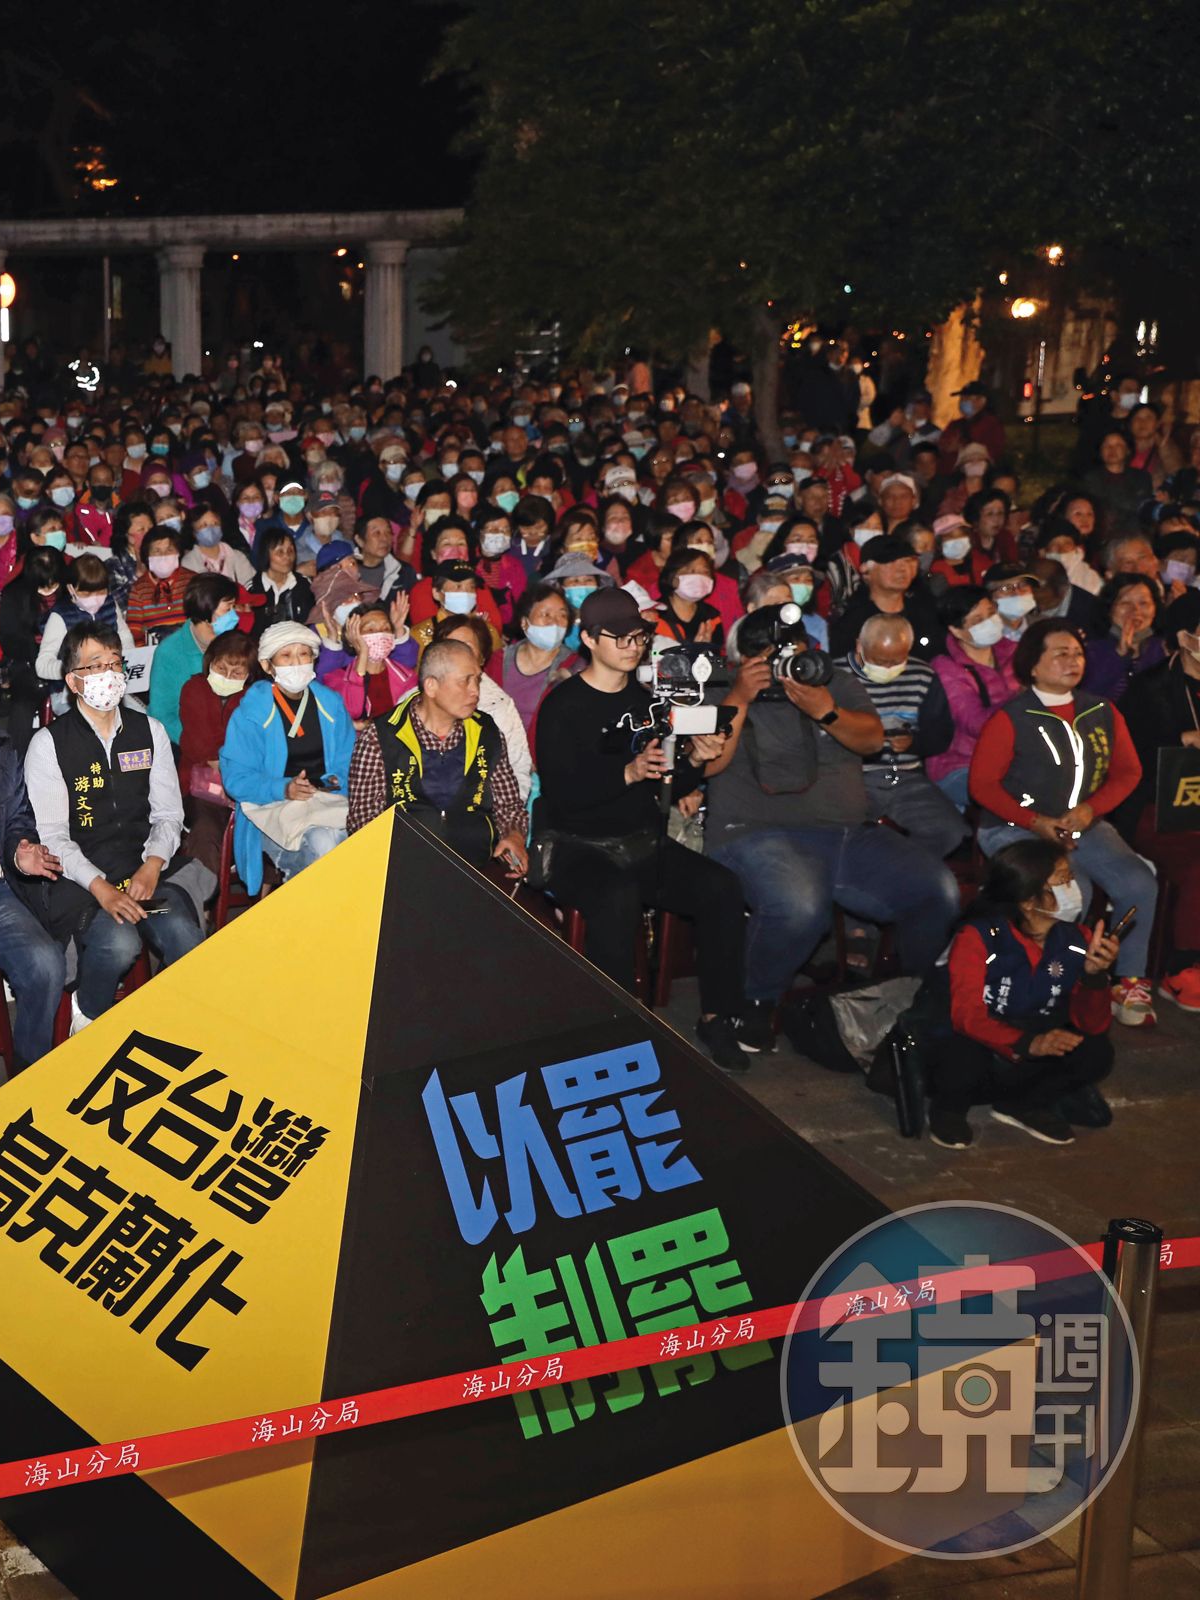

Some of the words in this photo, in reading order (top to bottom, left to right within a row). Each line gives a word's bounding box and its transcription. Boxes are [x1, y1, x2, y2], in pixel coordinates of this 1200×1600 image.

[90, 762, 105, 789] 特助
[75, 775, 94, 828] 游文沂
[66, 1030, 331, 1224] 反台灣
[421, 1039, 703, 1246] 以罷
[845, 1279, 936, 1317] 海山分局
[480, 1207, 775, 1440] 制罷
[659, 1317, 755, 1357] 海山分局
[462, 1357, 564, 1398] 海山分局
[251, 1400, 360, 1443] 海山分局
[24, 1443, 140, 1487] 海山分局
